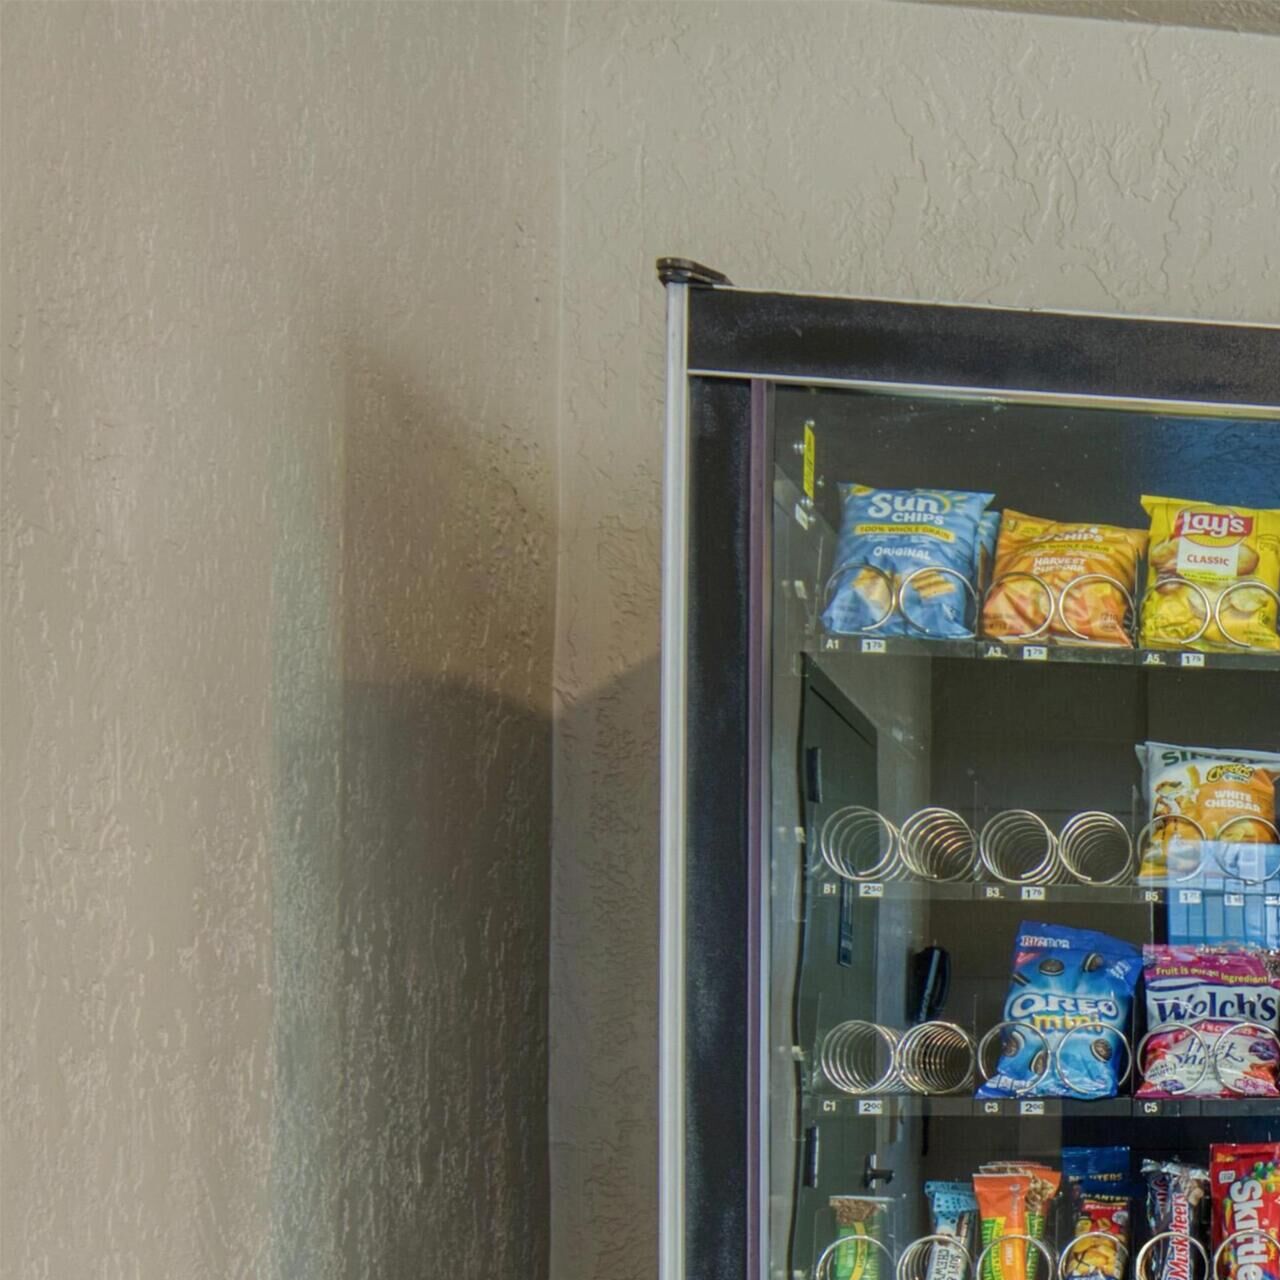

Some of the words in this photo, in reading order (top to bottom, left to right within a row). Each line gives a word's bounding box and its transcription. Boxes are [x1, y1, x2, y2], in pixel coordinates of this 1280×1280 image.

[868, 493, 938, 519] Sun
[892, 512, 944, 525] CHIPS
[1182, 511, 1247, 537] Lay's
[1187, 554, 1230, 567] CLASSIC
[825, 639, 839, 650] A1
[988, 647, 1002, 657] A3
[1146, 655, 1160, 665] A5
[1214, 790, 1252, 801] WHITE
[1205, 799, 1260, 812] CHEDDAR
[823, 884, 837, 896] B1
[986, 887, 1000, 898] B3
[1145, 891, 1158, 901] B5
[1156, 967, 1178, 976] Fruit
[1180, 967, 1189, 975] is
[1010, 993, 1120, 1019] OREO
[1153, 991, 1276, 1022] Welch's
[823, 1101, 836, 1112] C1
[985, 1103, 998, 1113] C3
[1144, 1102, 1158, 1113] C5
